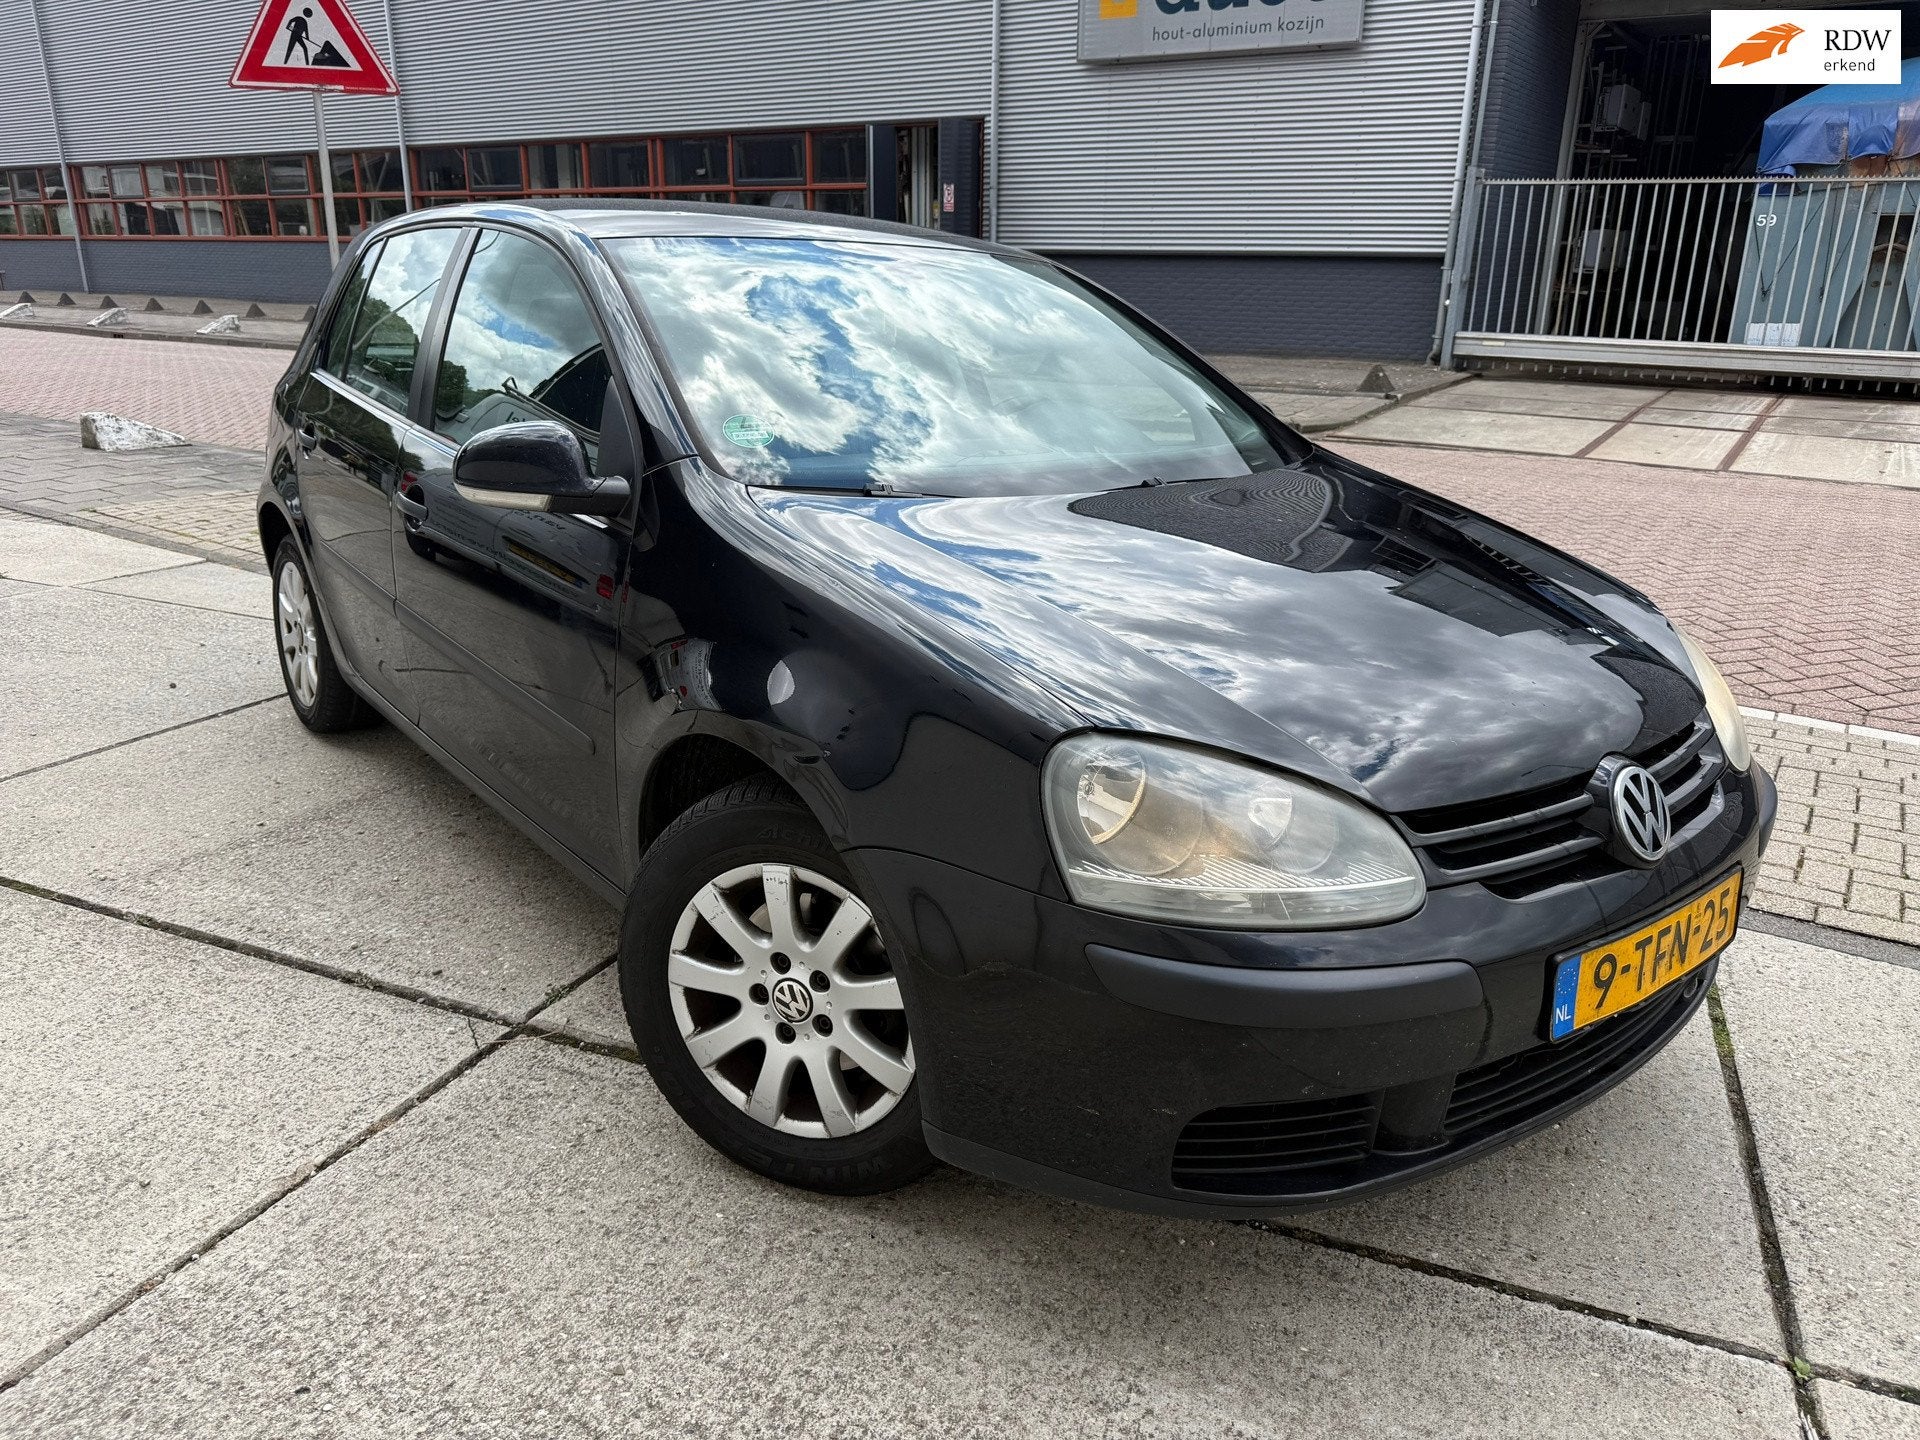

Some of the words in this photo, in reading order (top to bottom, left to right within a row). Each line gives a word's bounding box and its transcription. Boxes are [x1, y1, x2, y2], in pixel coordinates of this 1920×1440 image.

[1152, 21, 1272, 41] hout-aluminium
[1277, 15, 1324, 34] kozijn
[1593, 887, 1731, 1010] 9-TFN-25
[1555, 1003, 1572, 1025] NL
